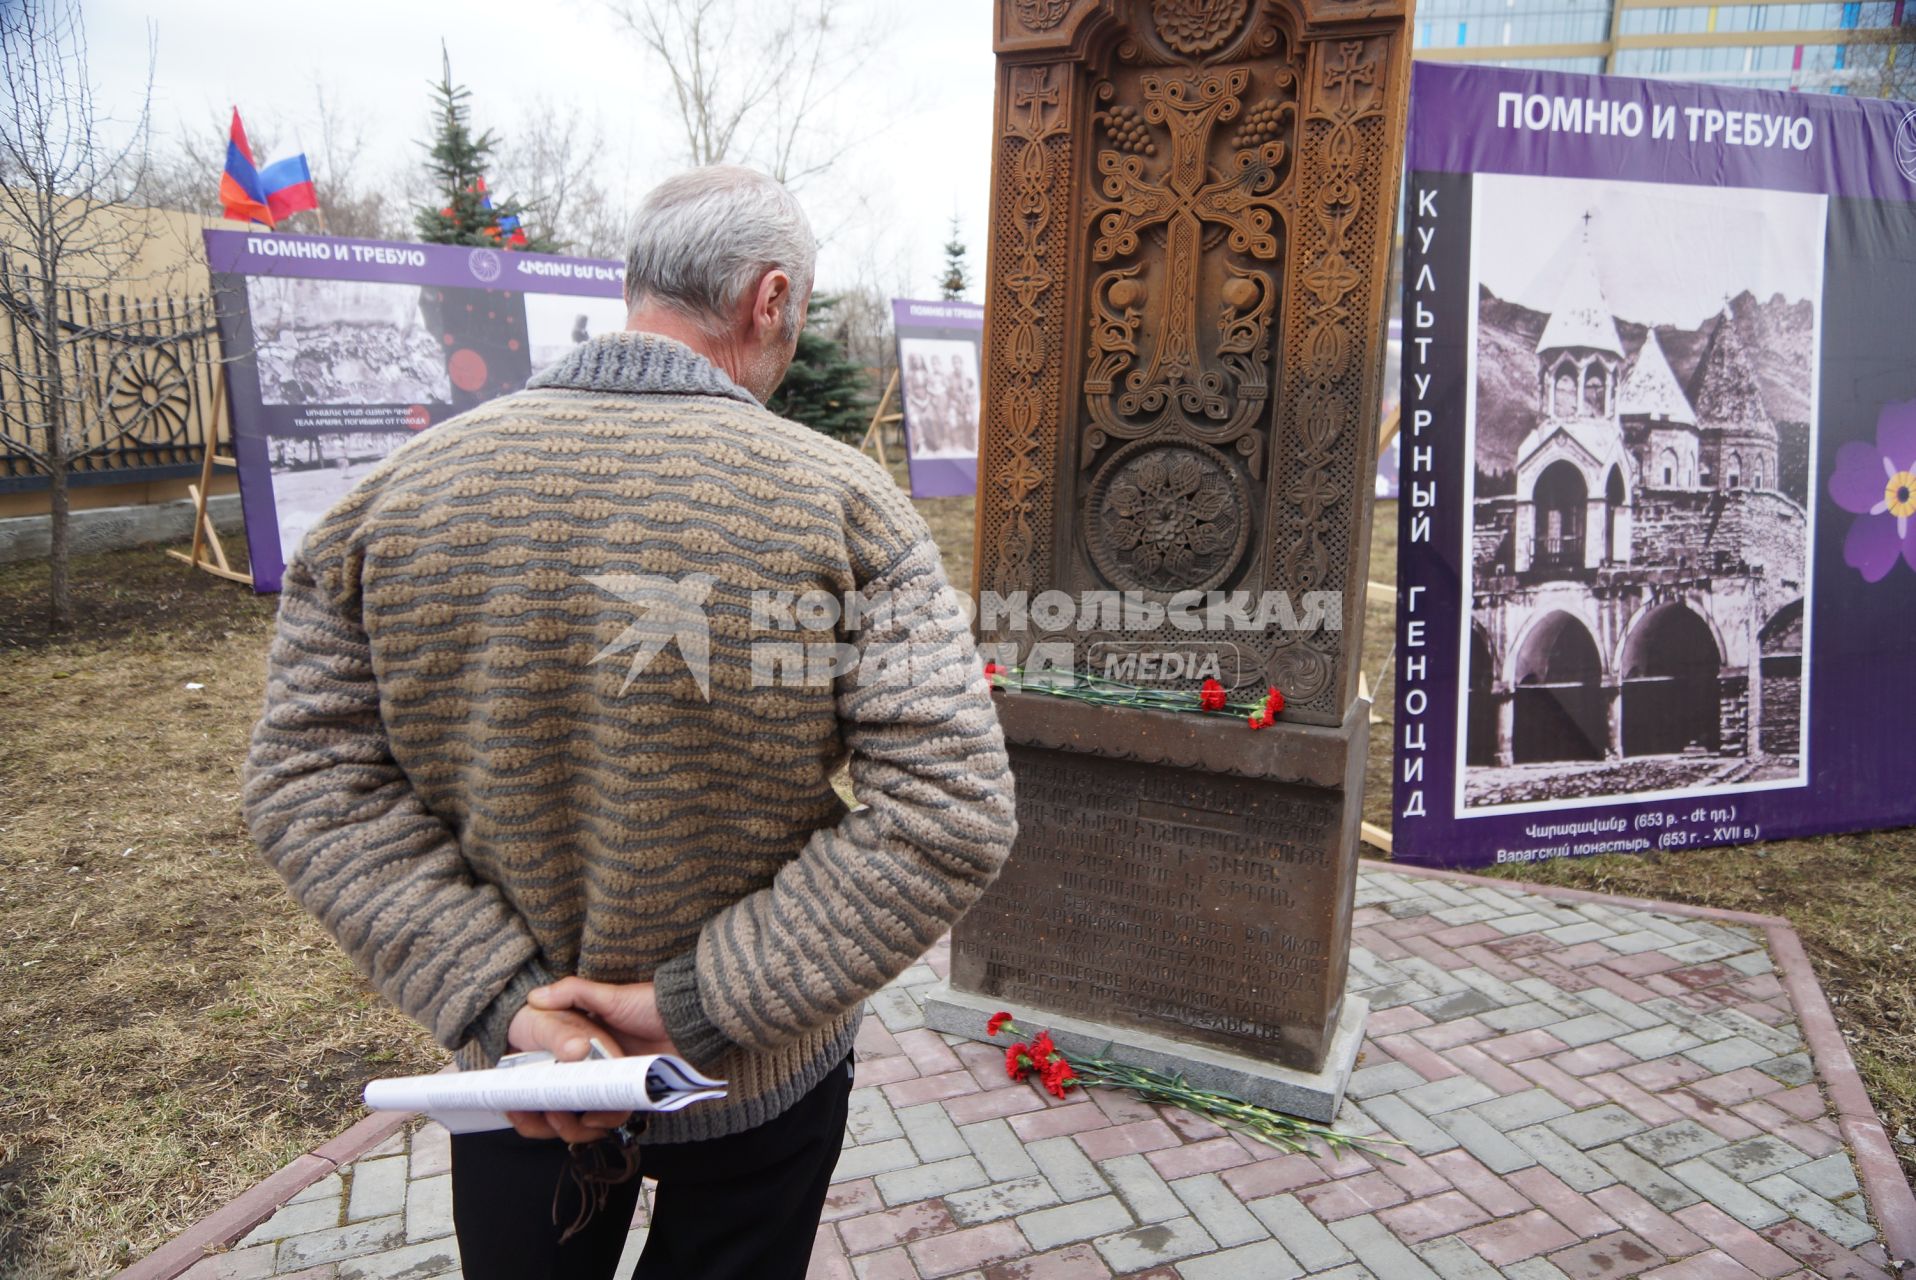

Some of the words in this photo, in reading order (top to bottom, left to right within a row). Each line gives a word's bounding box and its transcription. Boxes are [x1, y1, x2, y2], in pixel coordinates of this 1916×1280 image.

[1497, 92, 1643, 137] ПОМНЮ
[1652, 106, 1675, 140] И
[1684, 108, 1813, 150] ТРЕБУЮ
[247, 237, 330, 259] ПОМНЮ
[334, 245, 349, 261] И
[352, 245, 425, 267] ТРЕБУЮ
[1410, 189, 1438, 543] КУЛЬТУРНЫЙ
[1402, 586, 1428, 818] ГЕНОЦИД
[1497, 844, 1570, 864] Варагский
[1573, 838, 1650, 857] монастырь
[1658, 831, 1687, 850] (653
[1713, 826, 1740, 841] XVII
[1525, 819, 1627, 839] Վարագավանք
[1634, 812, 1663, 831] (653
[1175, 913, 1231, 939] КРЕСТ
[1282, 934, 1319, 956] ИМЯ
[987, 962, 1059, 990] ПЕРВОГО
[1093, 934, 1234, 976] БЛАГОДЕТЕЛЯМИ
[1242, 963, 1260, 981] ИЗ
[1268, 969, 1316, 994] РОДА
[1129, 976, 1228, 1011] КАТОЛИКОСА
